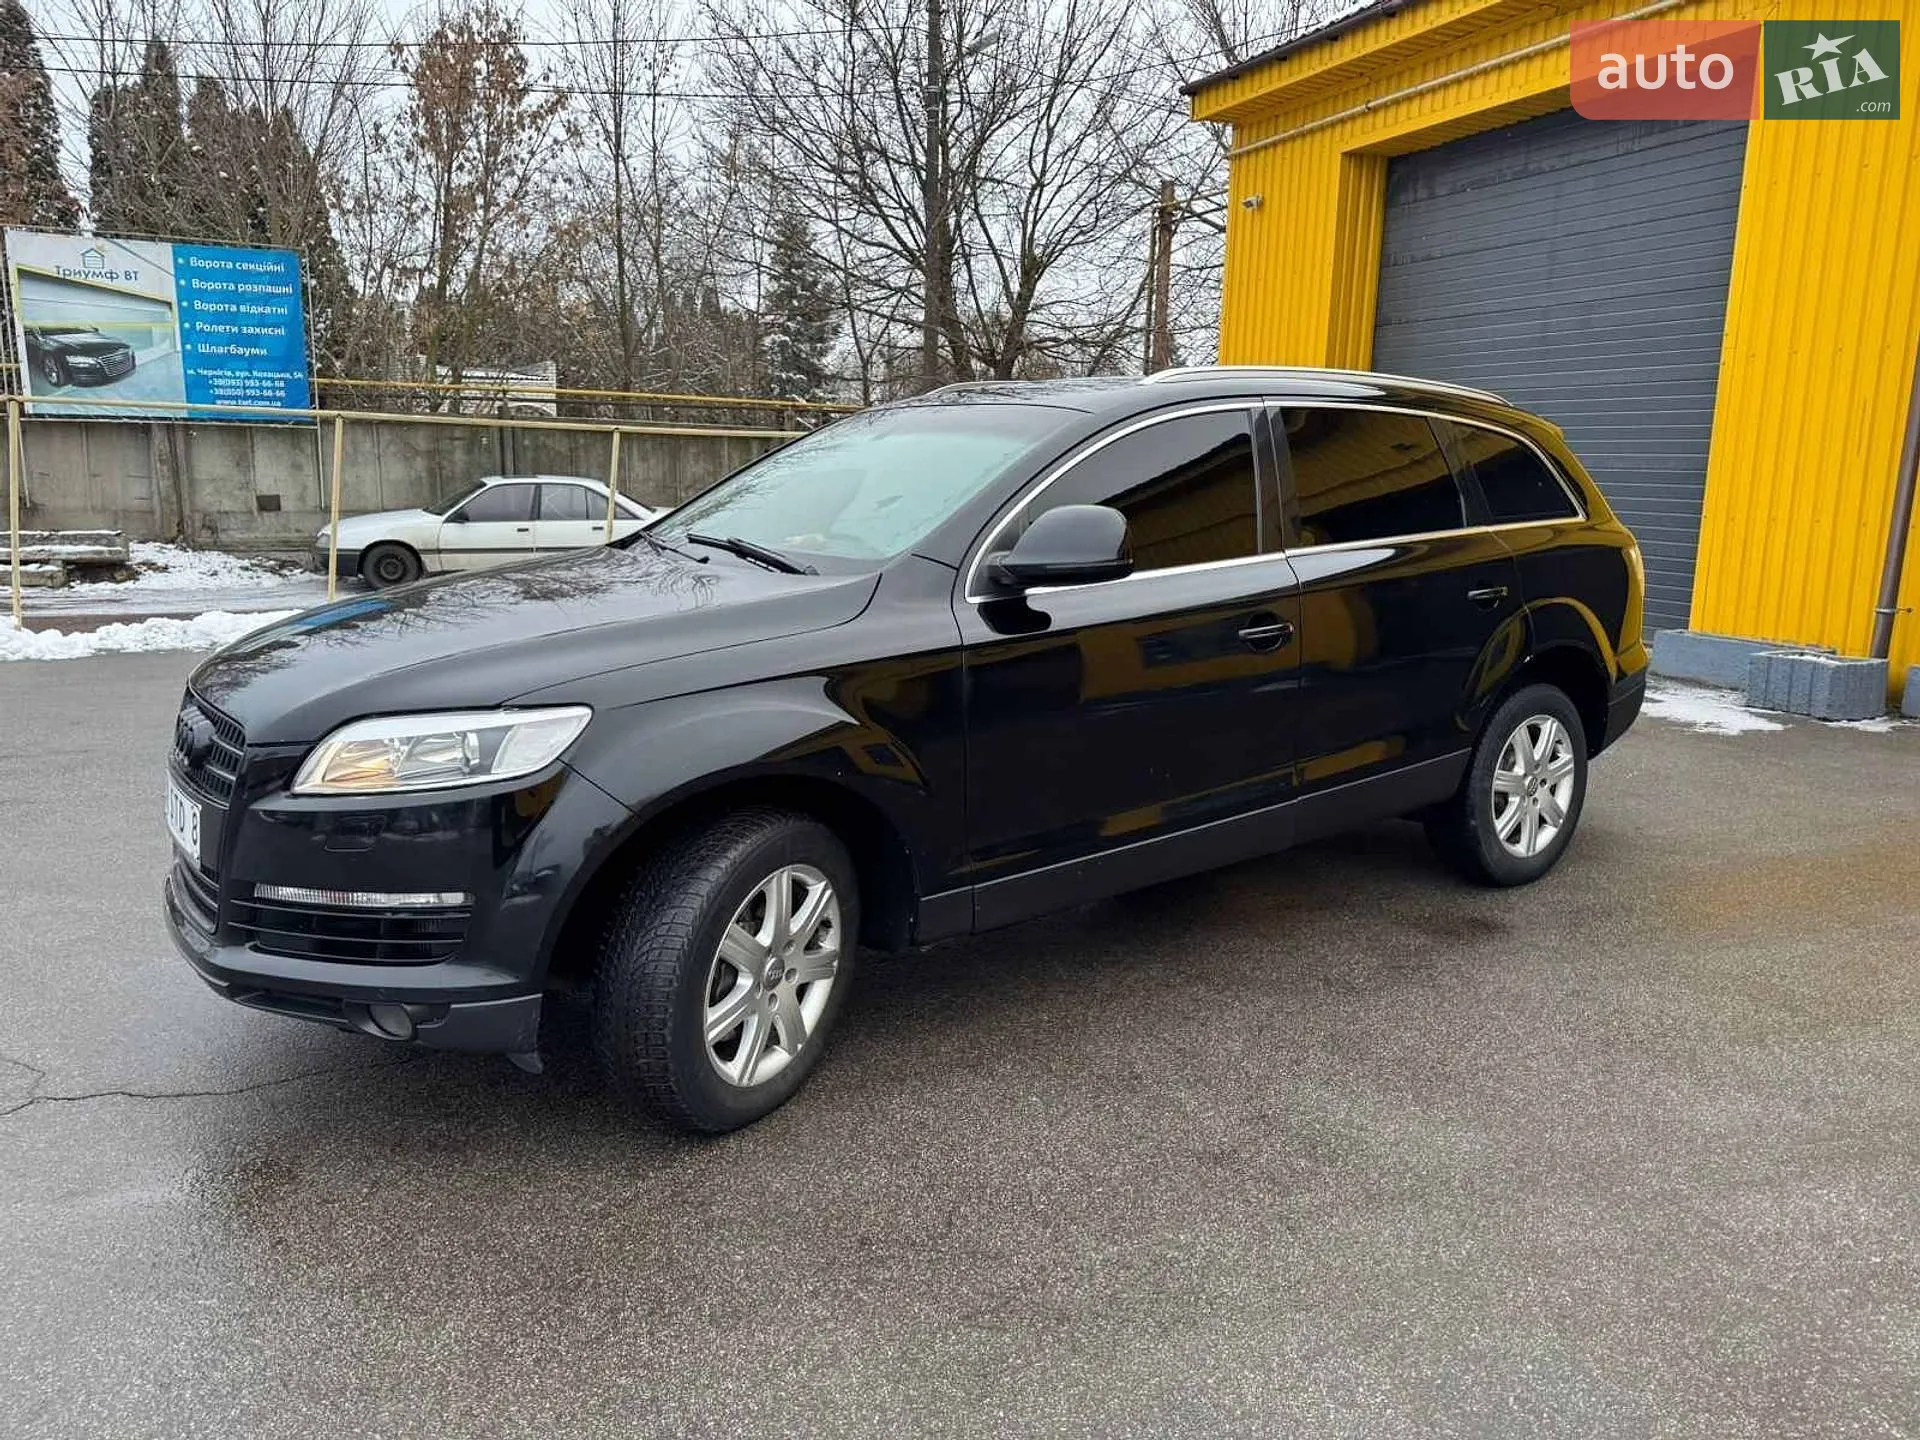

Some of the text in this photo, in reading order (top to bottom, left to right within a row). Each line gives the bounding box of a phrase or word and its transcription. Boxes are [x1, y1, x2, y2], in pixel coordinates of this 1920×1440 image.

[189, 256, 285, 273] Ворота секційні
[54, 265, 119, 281] Триумф
[191, 278, 293, 294] Ворота розпашні
[193, 299, 288, 316] Ворота відкатні
[195, 321, 285, 336] Ролети захисні
[198, 343, 268, 356] Шлагбауми
